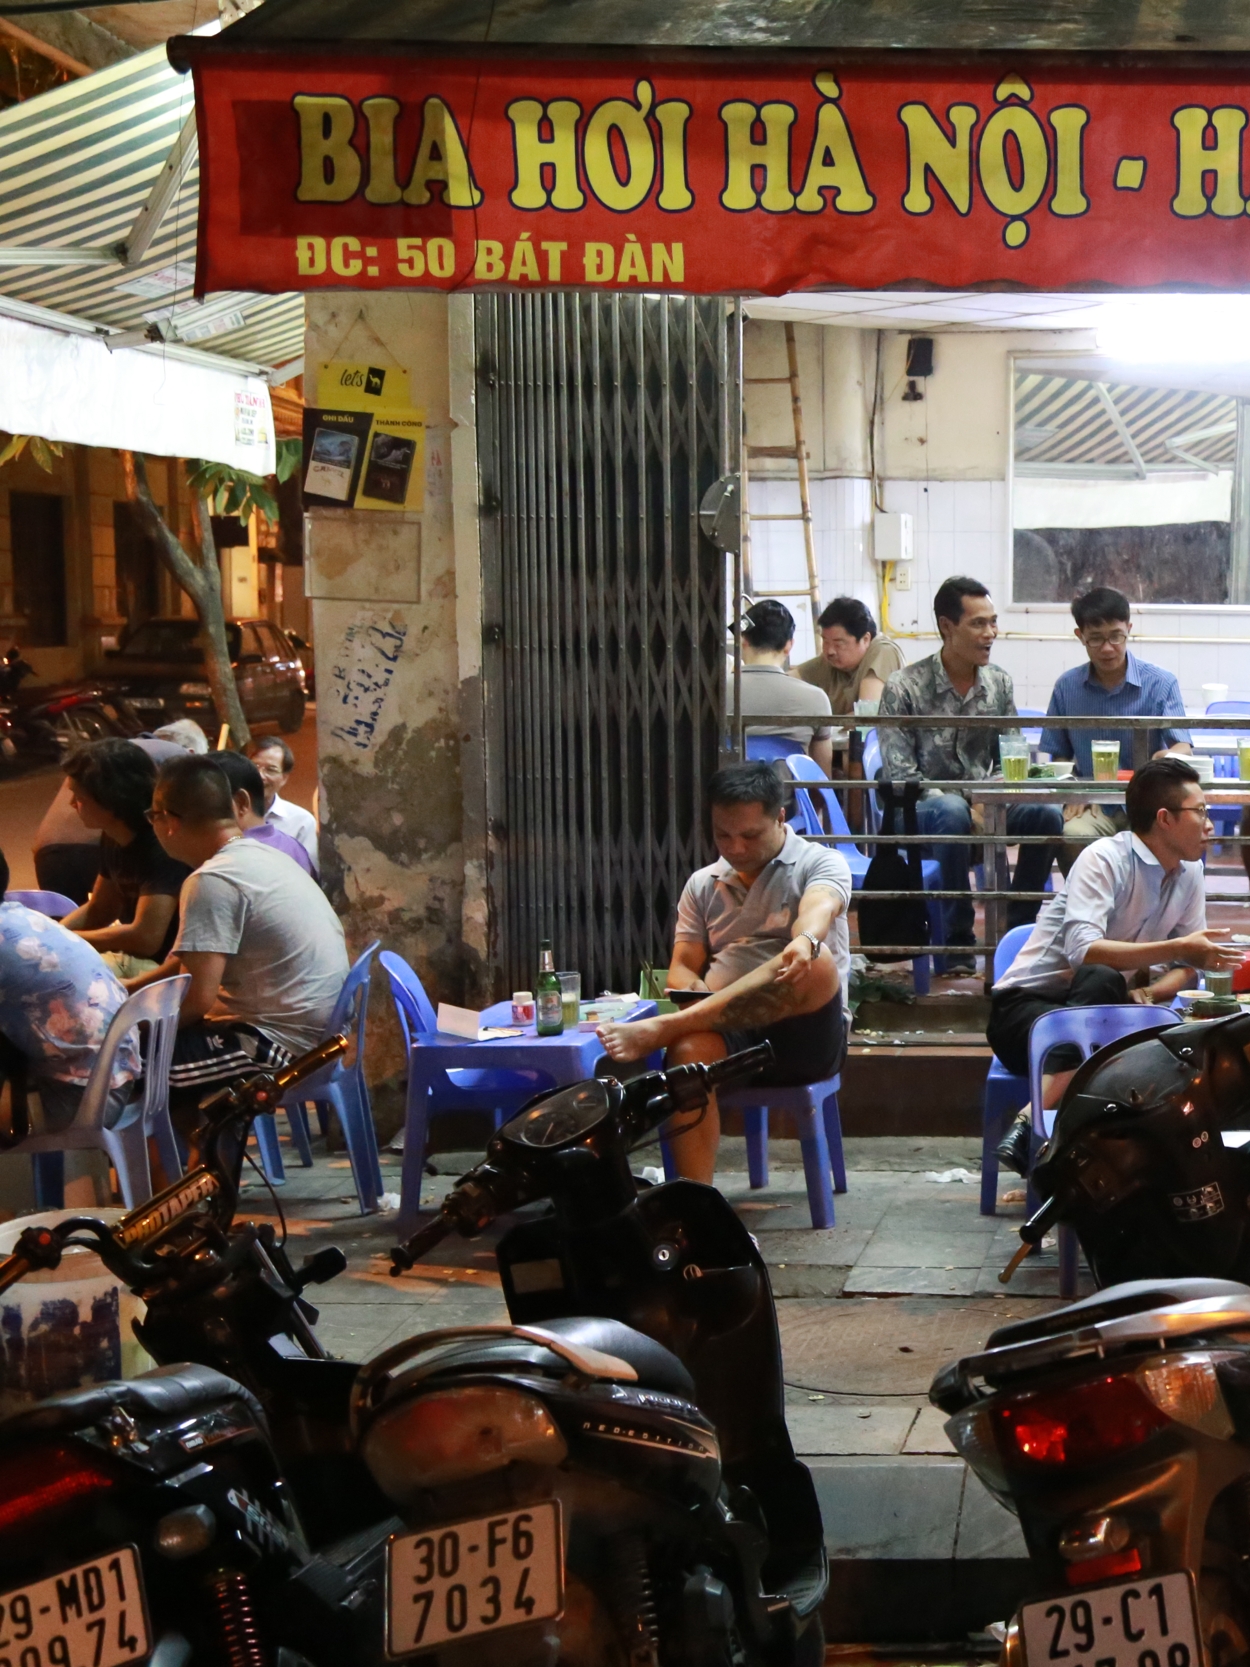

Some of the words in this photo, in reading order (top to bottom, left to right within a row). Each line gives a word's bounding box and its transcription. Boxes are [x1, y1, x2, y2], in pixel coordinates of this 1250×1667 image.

[293, 94, 483, 209] BIA
[506, 79, 695, 212] HƠI
[719, 72, 876, 214] HÀ
[898, 74, 1089, 248] NỘI
[295, 235, 379, 277] ĐC:
[396, 237, 456, 278] 50
[475, 232, 568, 281] BÁT
[582, 233, 685, 283] ĐÀN
[340, 369, 365, 387] let's
[413, 1513, 534, 1585] 30-F6
[412, 1567, 536, 1644] 7034
[1045, 1583, 1169, 1660] 29-C1
